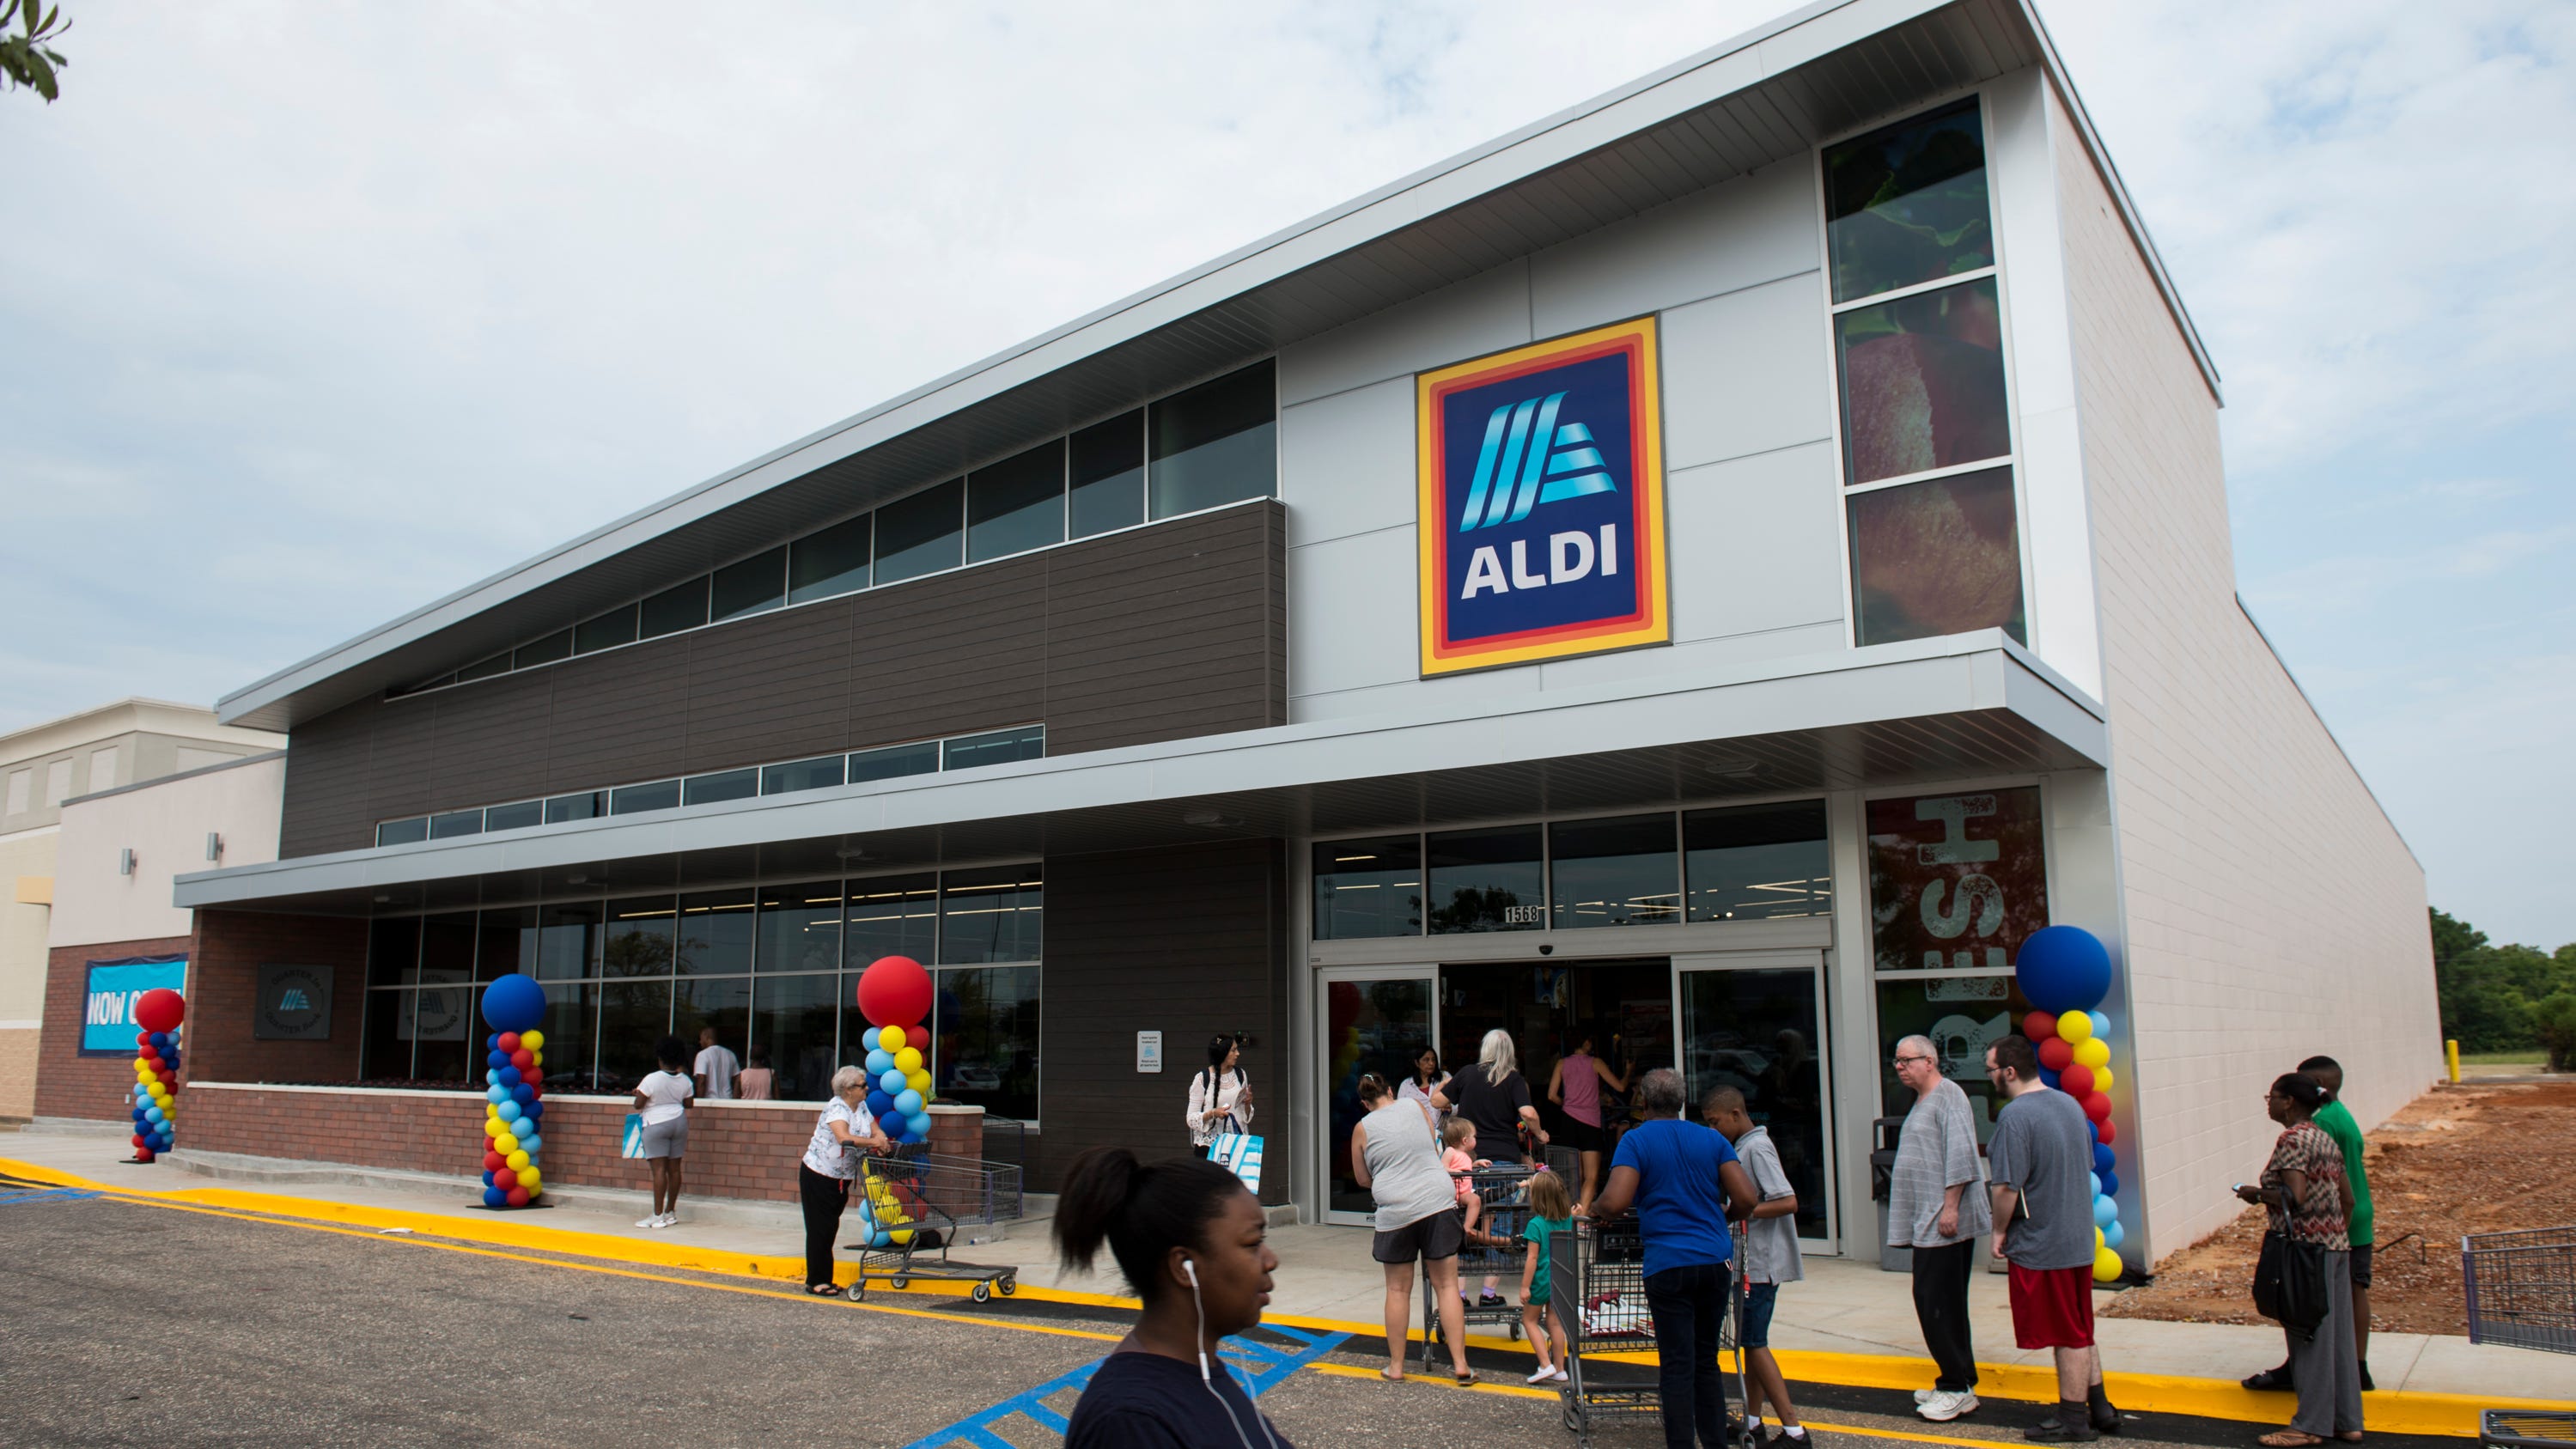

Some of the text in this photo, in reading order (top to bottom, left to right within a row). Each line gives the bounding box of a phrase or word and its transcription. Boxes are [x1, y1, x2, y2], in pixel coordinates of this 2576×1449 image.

[1461, 523, 1617, 600] ALDI
[1507, 906, 1538, 922] 1568
[87, 991, 127, 1026] NOW
